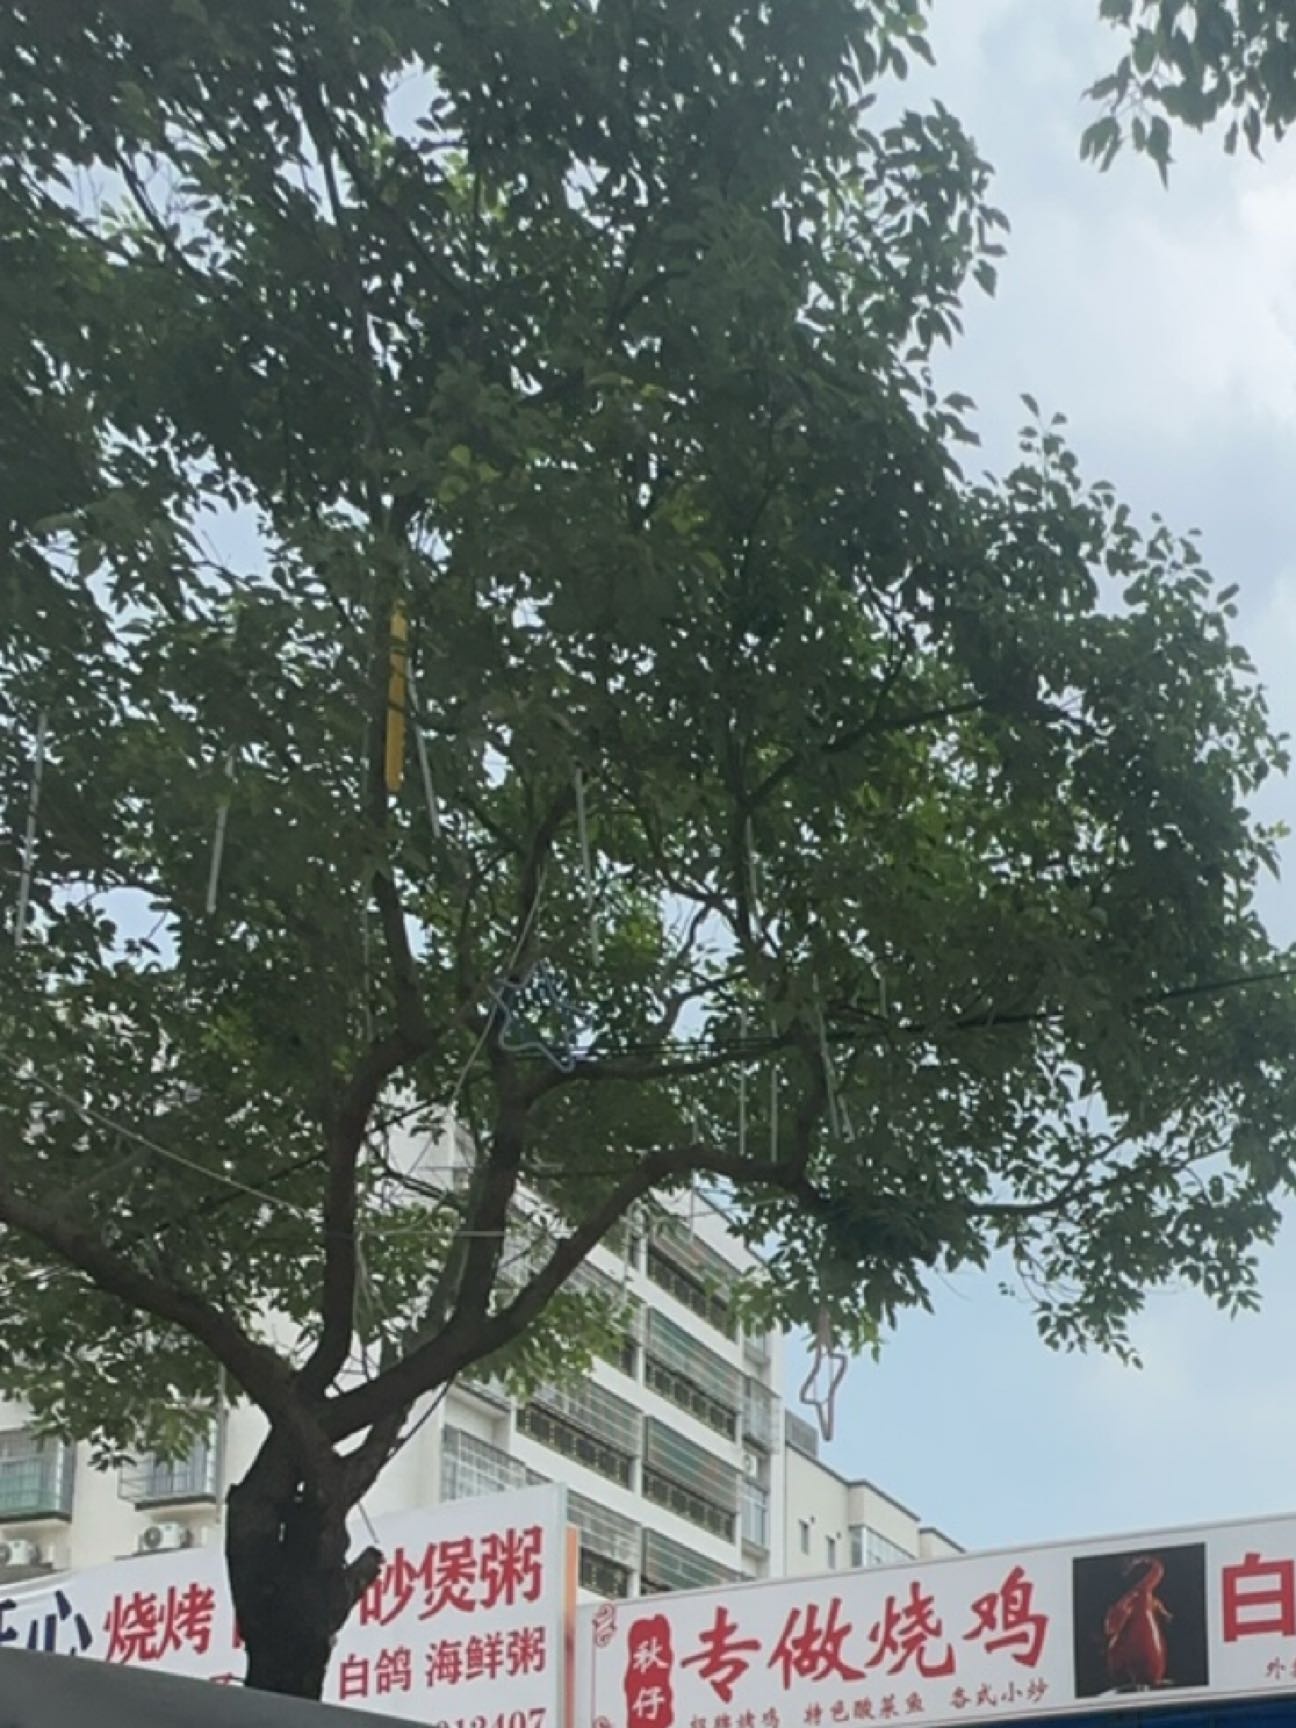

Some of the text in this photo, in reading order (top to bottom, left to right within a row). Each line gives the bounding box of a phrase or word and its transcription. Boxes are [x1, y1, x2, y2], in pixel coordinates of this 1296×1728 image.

[103, 1582, 215, 1664] 烧烤
[681, 1565, 1050, 1704] 专做烧鸡
[339, 1626, 546, 1700] 白鸽 海鲜粥
[803, 1692, 924, 1727] 特色酸菜鱼
